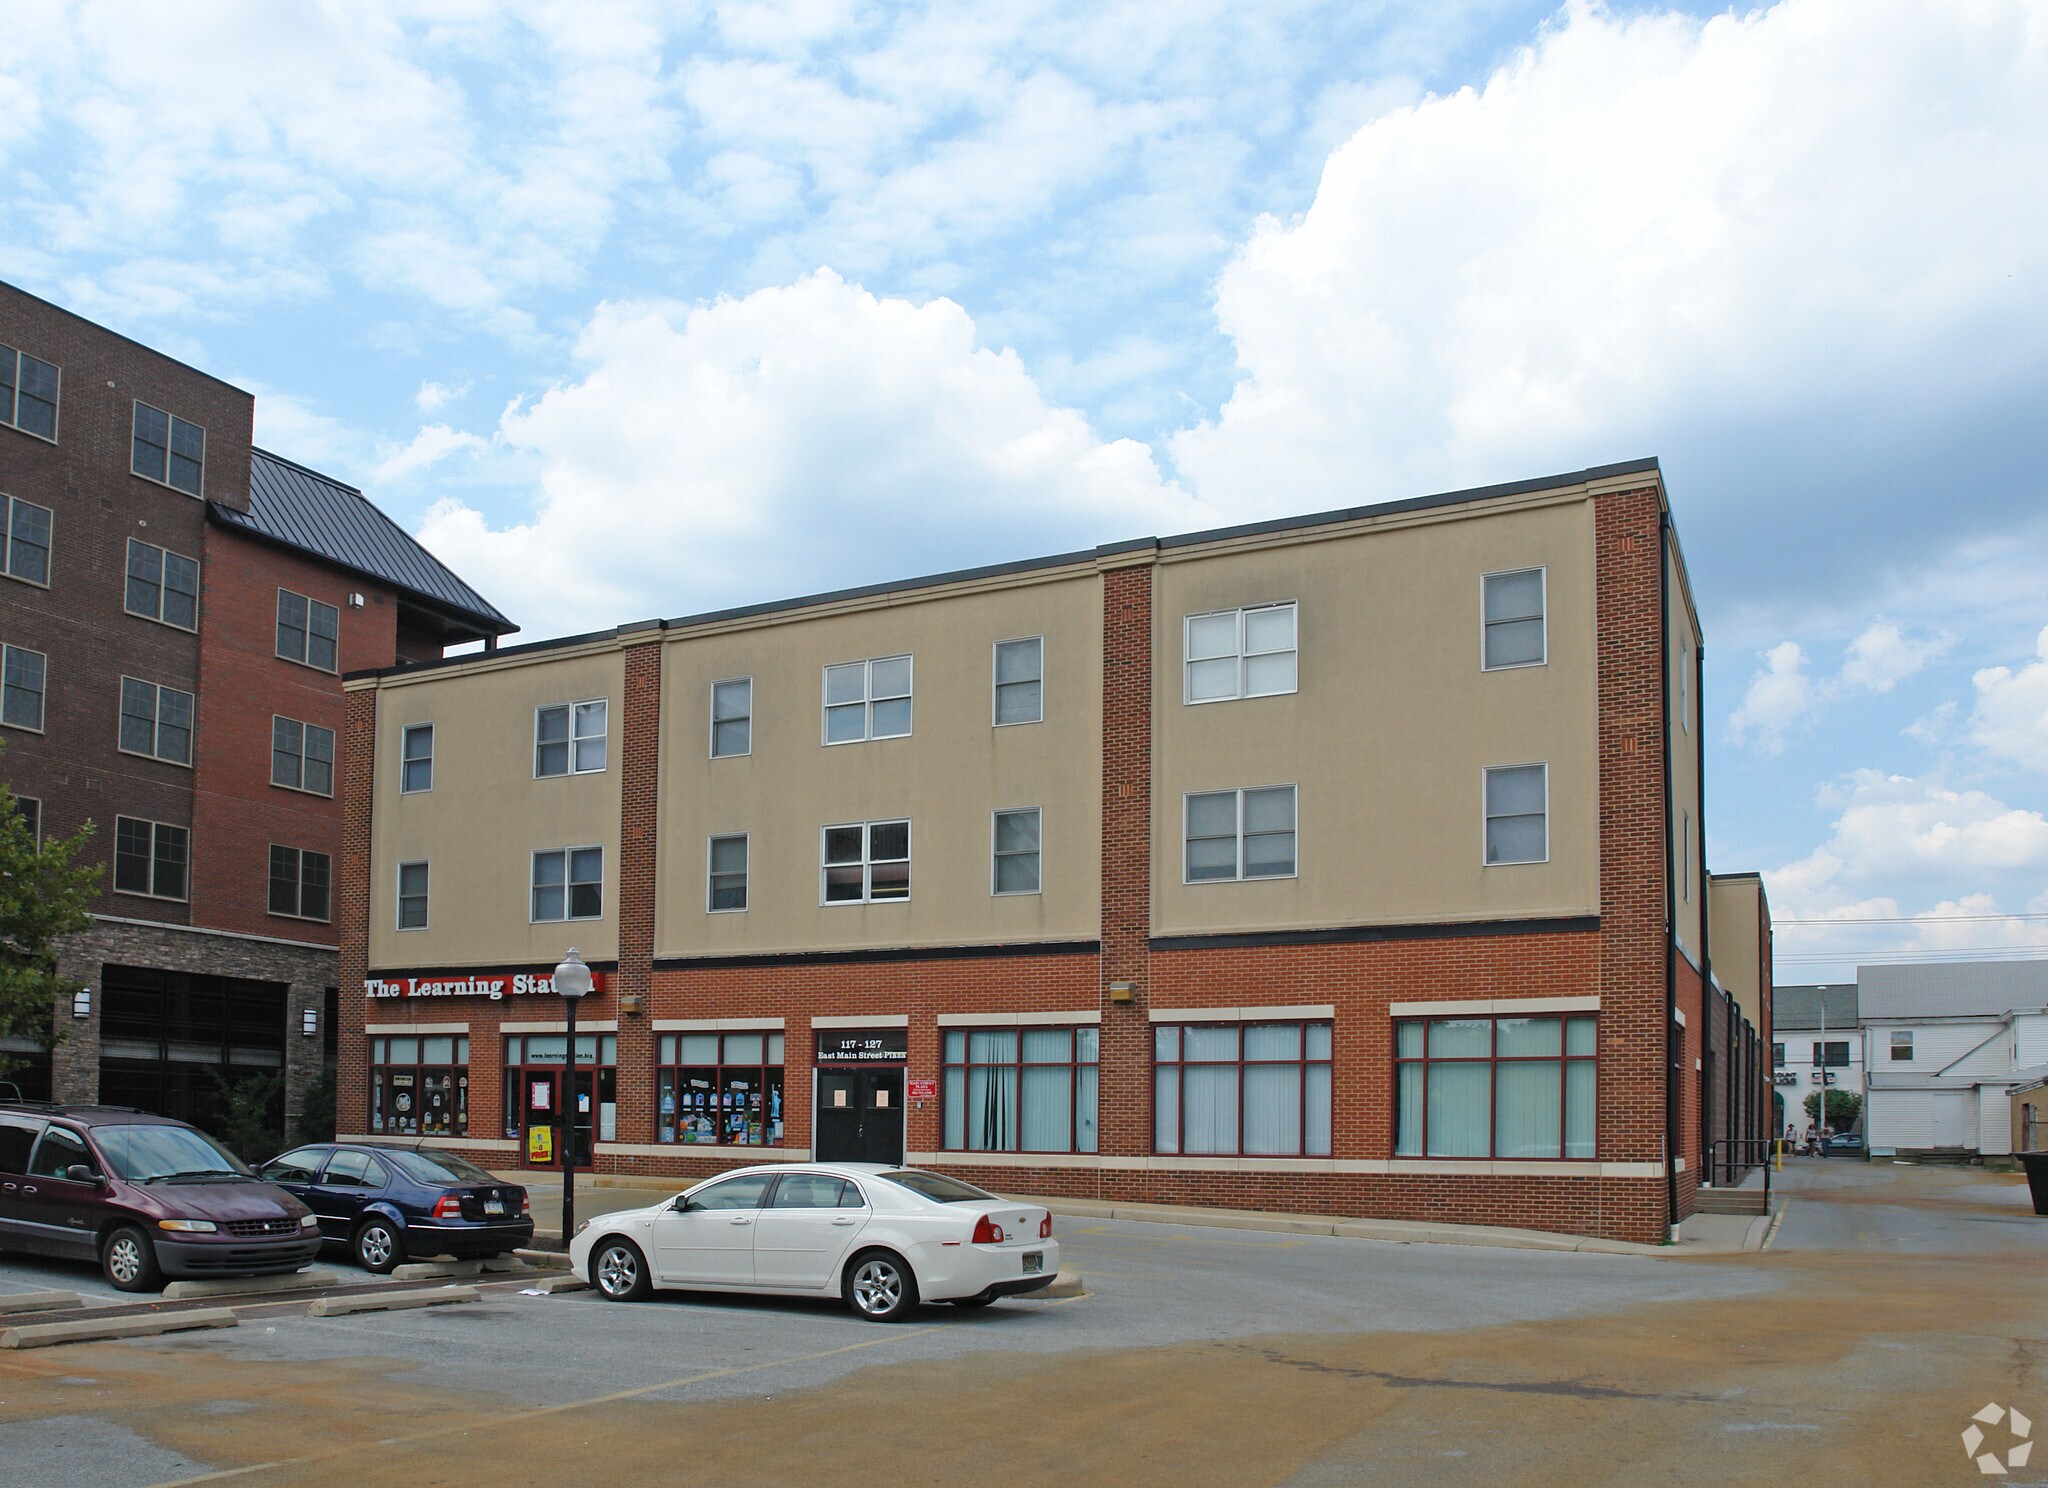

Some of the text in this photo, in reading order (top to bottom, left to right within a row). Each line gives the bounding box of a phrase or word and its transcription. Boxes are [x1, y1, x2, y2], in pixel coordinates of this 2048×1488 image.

[364, 974, 596, 1000] The Learning Stat
[840, 1040, 857, 1049] 117
[864, 1040, 883, 1049] 127
[817, 1051, 835, 1059] East
[836, 1051, 857, 1059] Main
[858, 1051, 882, 1059] Street
